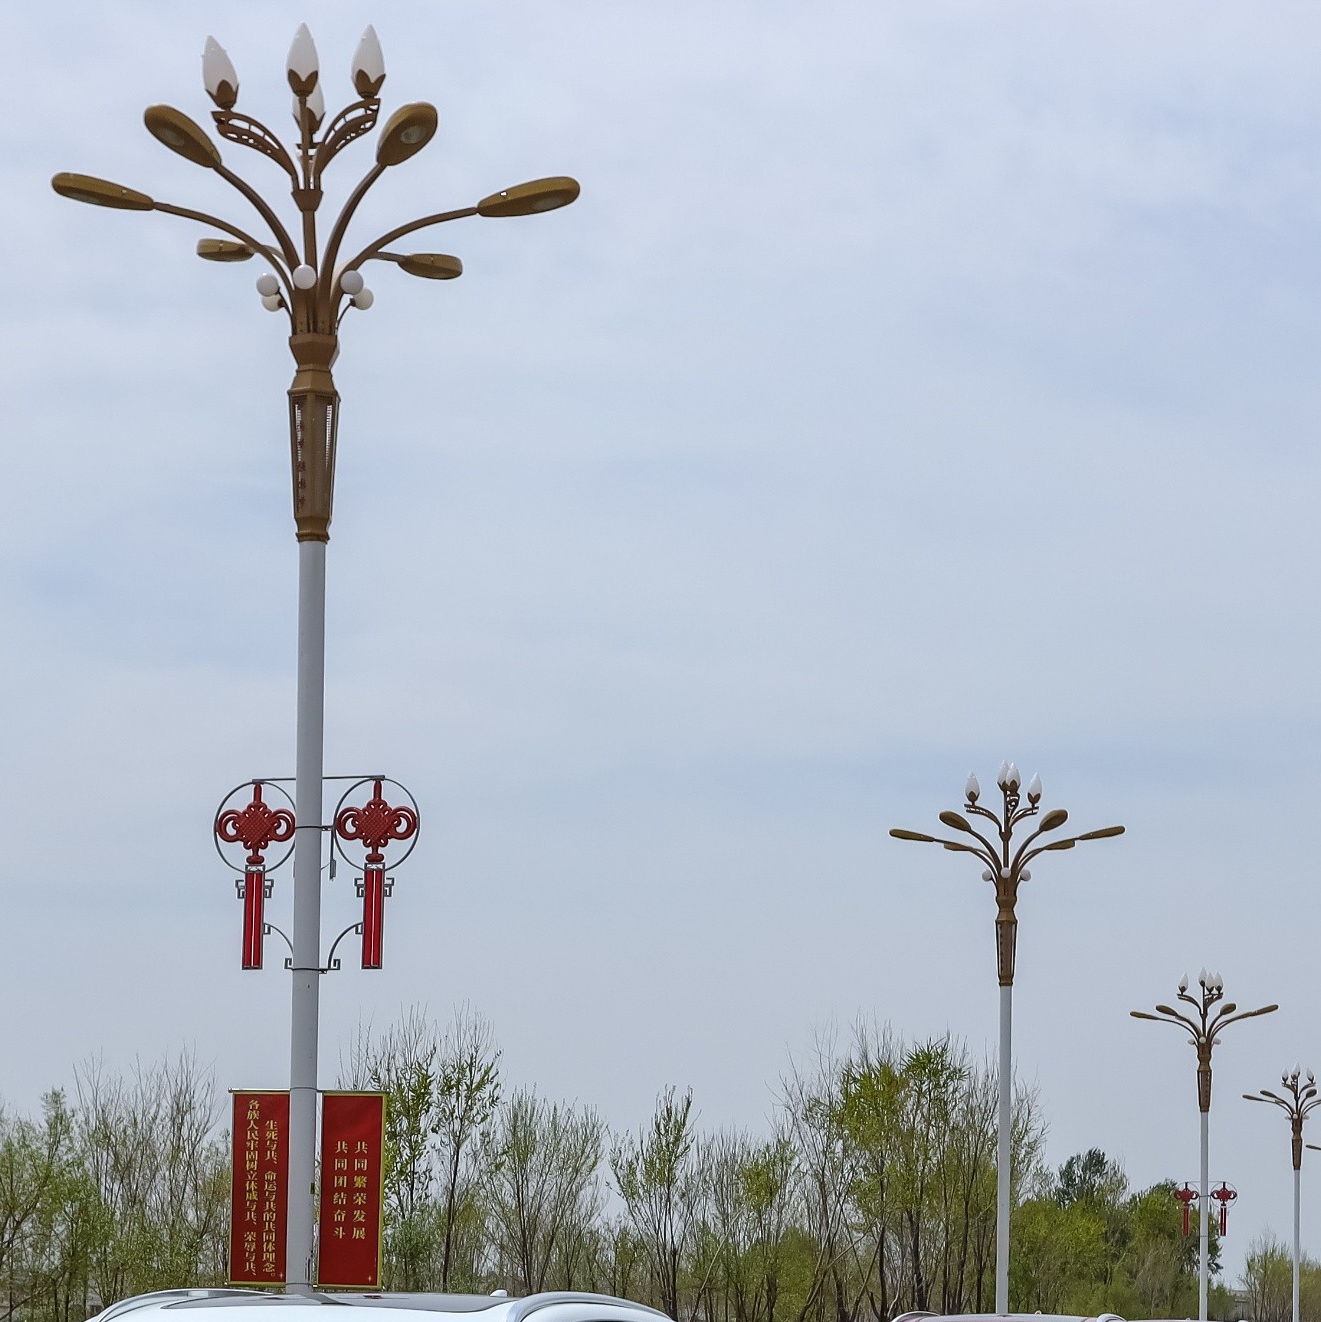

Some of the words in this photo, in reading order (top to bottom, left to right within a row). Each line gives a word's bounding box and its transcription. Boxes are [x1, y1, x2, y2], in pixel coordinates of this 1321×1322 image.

[333, 1140, 348, 1239] 共同团结奋斗
[352, 1141, 368, 1240] 共同繁荣发展
